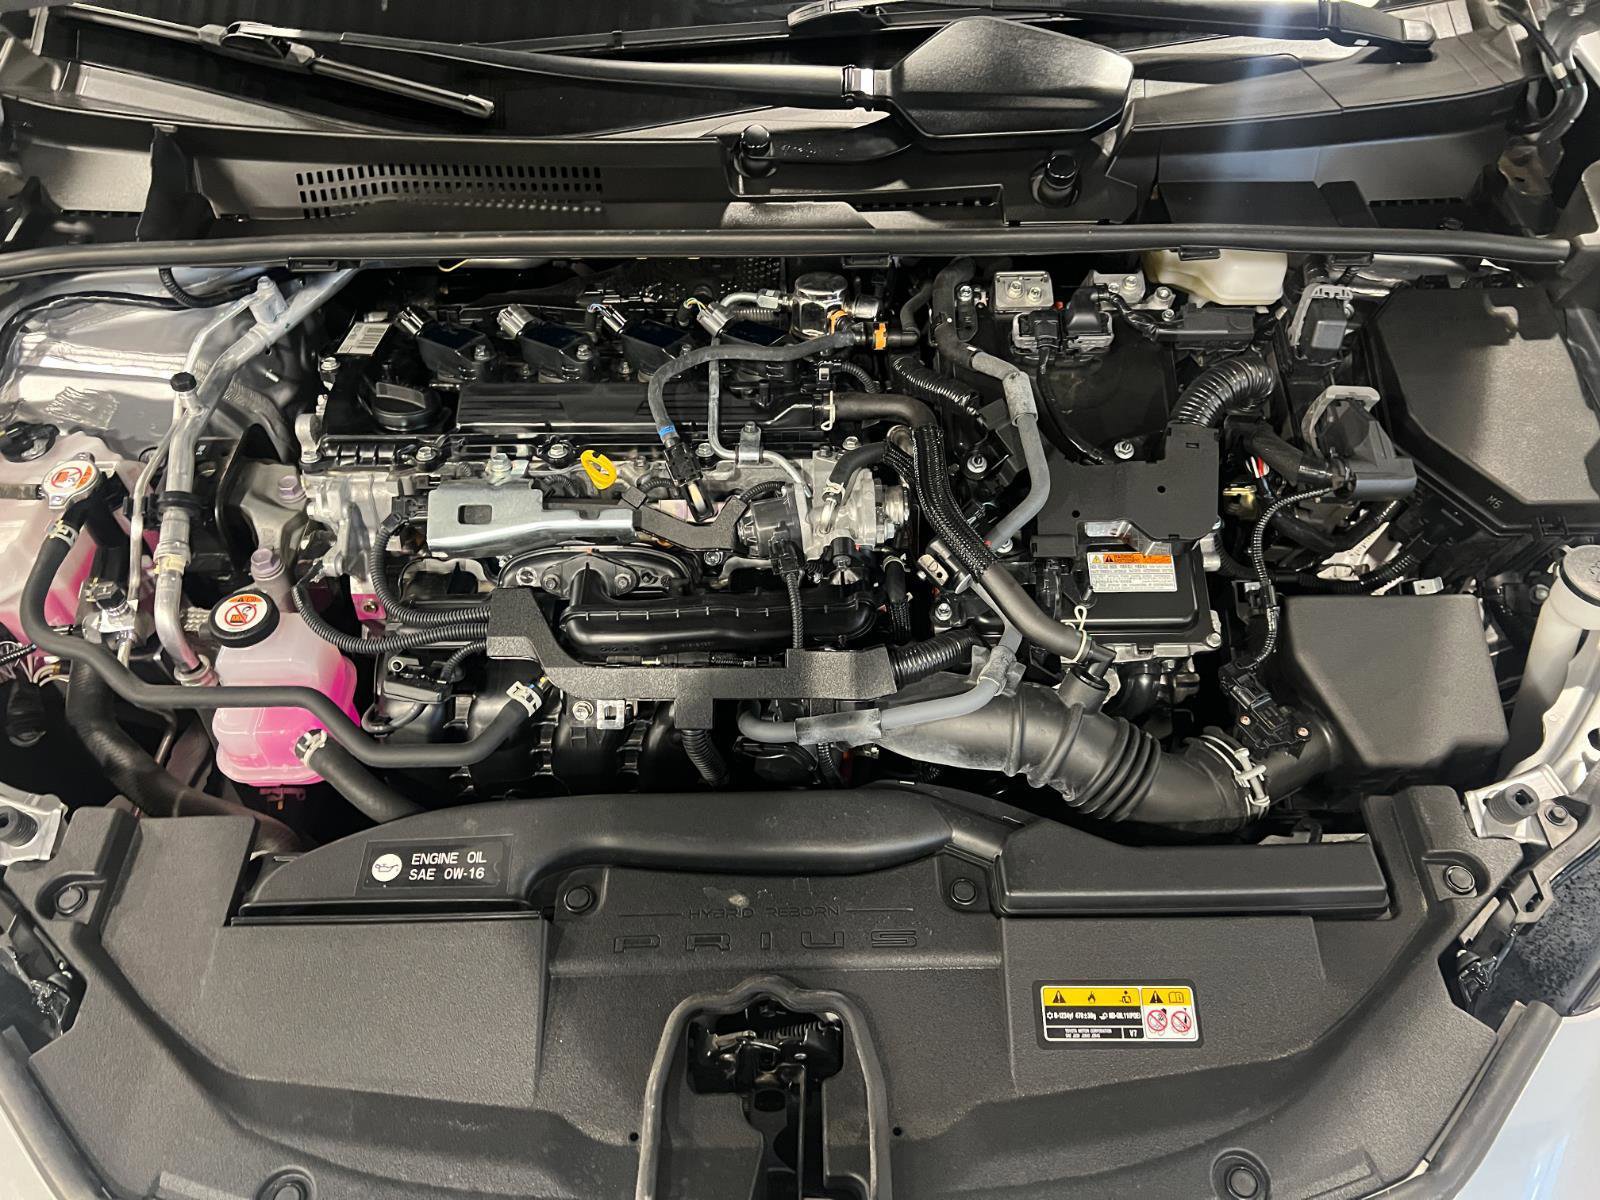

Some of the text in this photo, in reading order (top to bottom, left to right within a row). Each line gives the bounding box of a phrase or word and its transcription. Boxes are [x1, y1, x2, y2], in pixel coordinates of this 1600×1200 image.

[411, 851, 487, 865] ENGINE OIL
[408, 867, 485, 880] SAE 0W-16
[688, 903, 841, 920] HYBRID REBORN
[612, 929, 919, 954] PRIUS
[1129, 1029, 1138, 1038] V7
